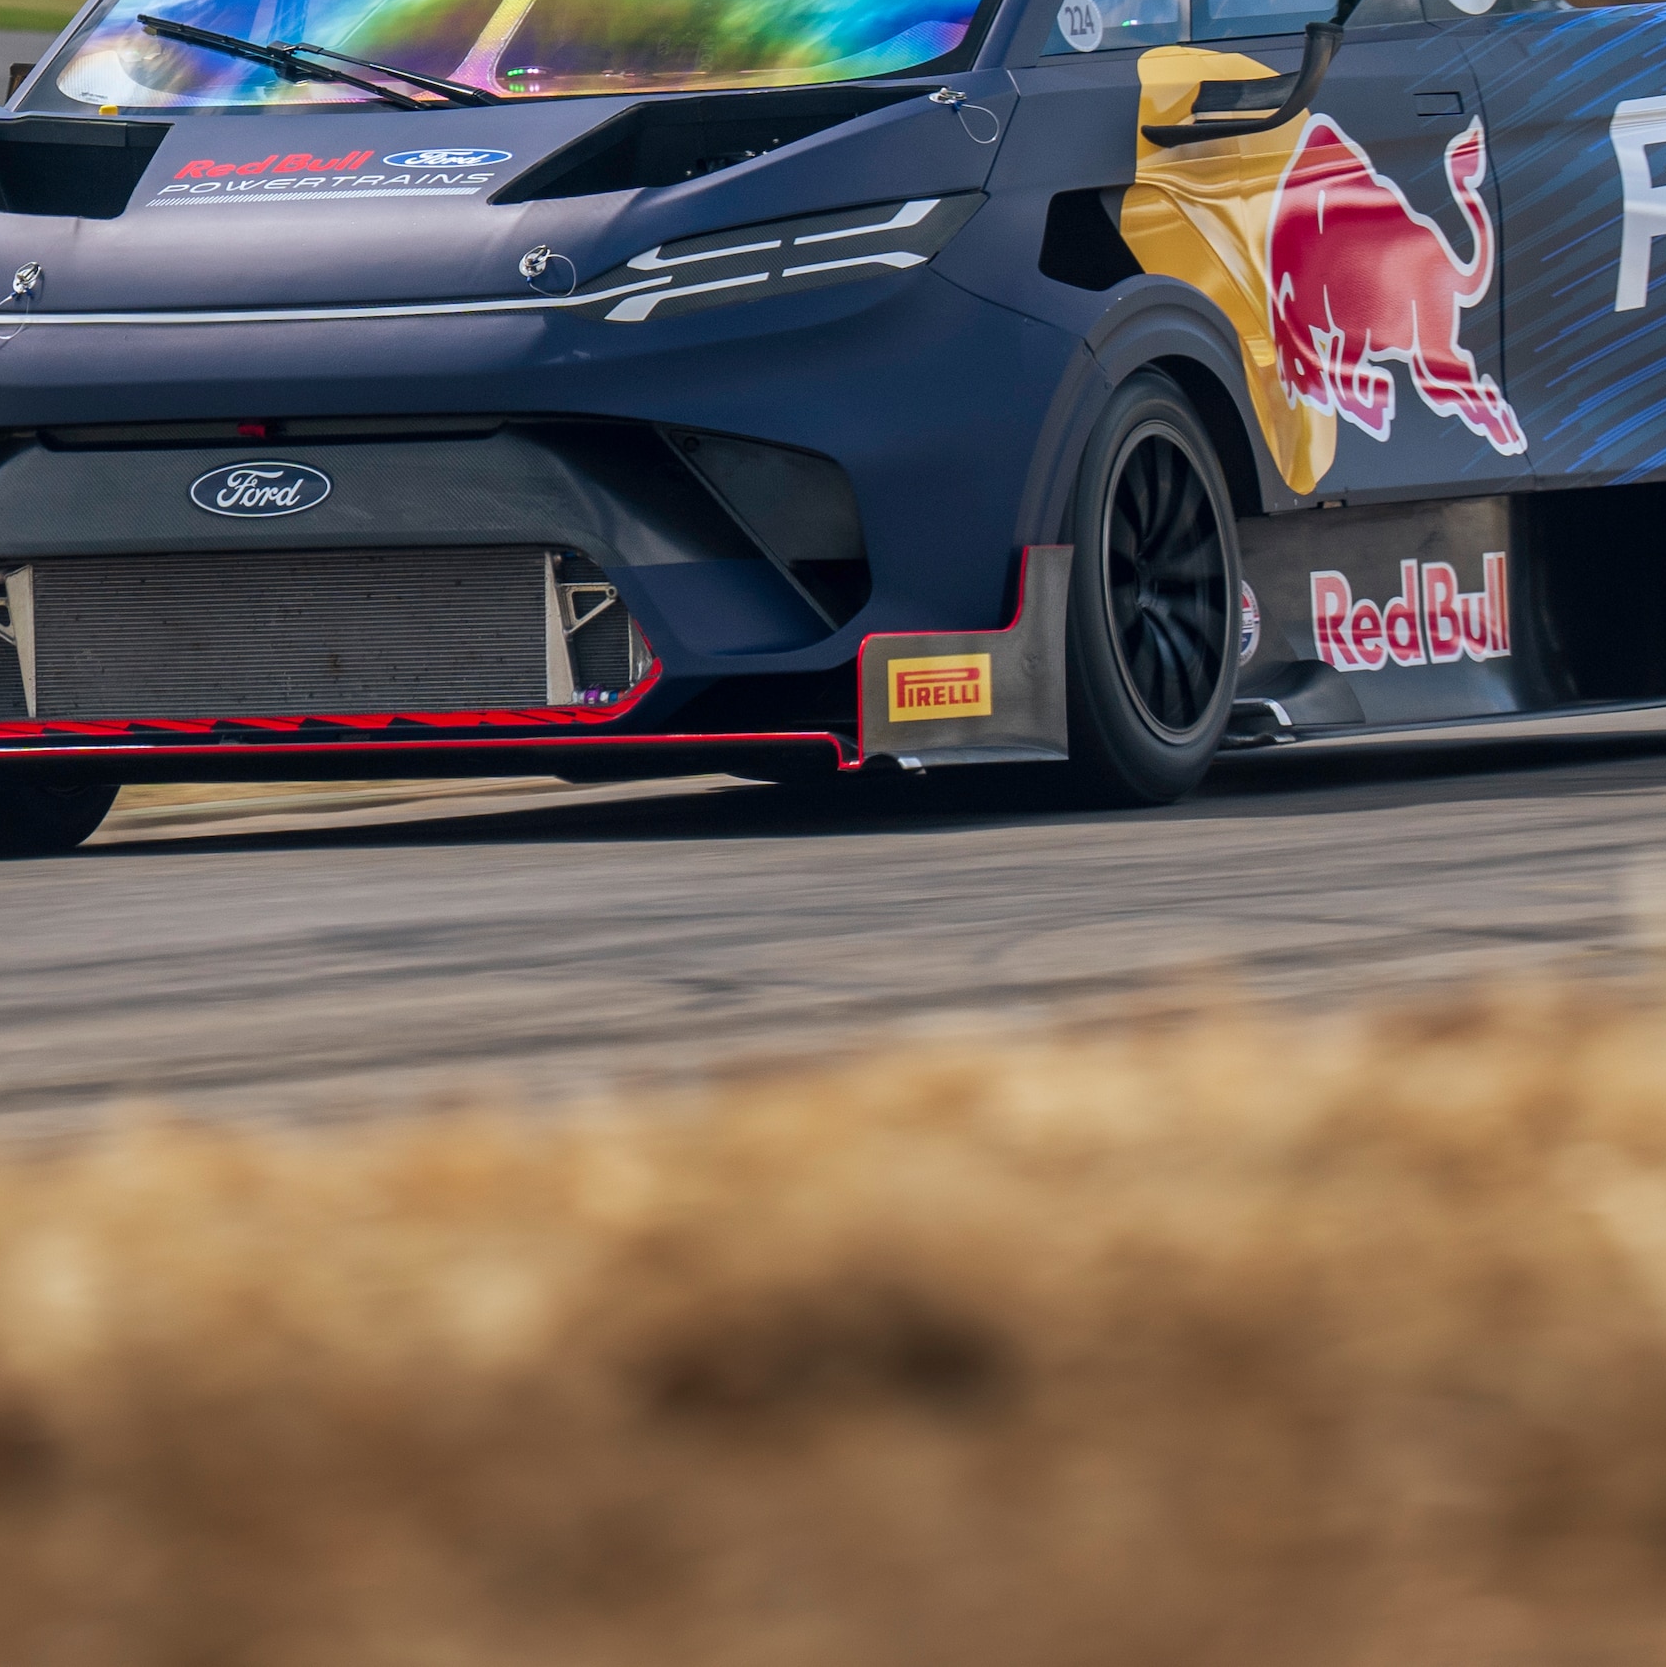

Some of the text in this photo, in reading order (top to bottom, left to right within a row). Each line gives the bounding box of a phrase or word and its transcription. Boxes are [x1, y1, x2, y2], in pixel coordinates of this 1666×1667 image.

[1064, 4, 1095, 36] 224
[173, 150, 375, 180] Red Bull
[157, 172, 495, 196] POWERTRAINS
[216, 469, 305, 508] Ford
[1311, 558, 1426, 672] Red
[1422, 551, 1511, 664] Bull
[896, 667, 980, 709] PIRELLI
